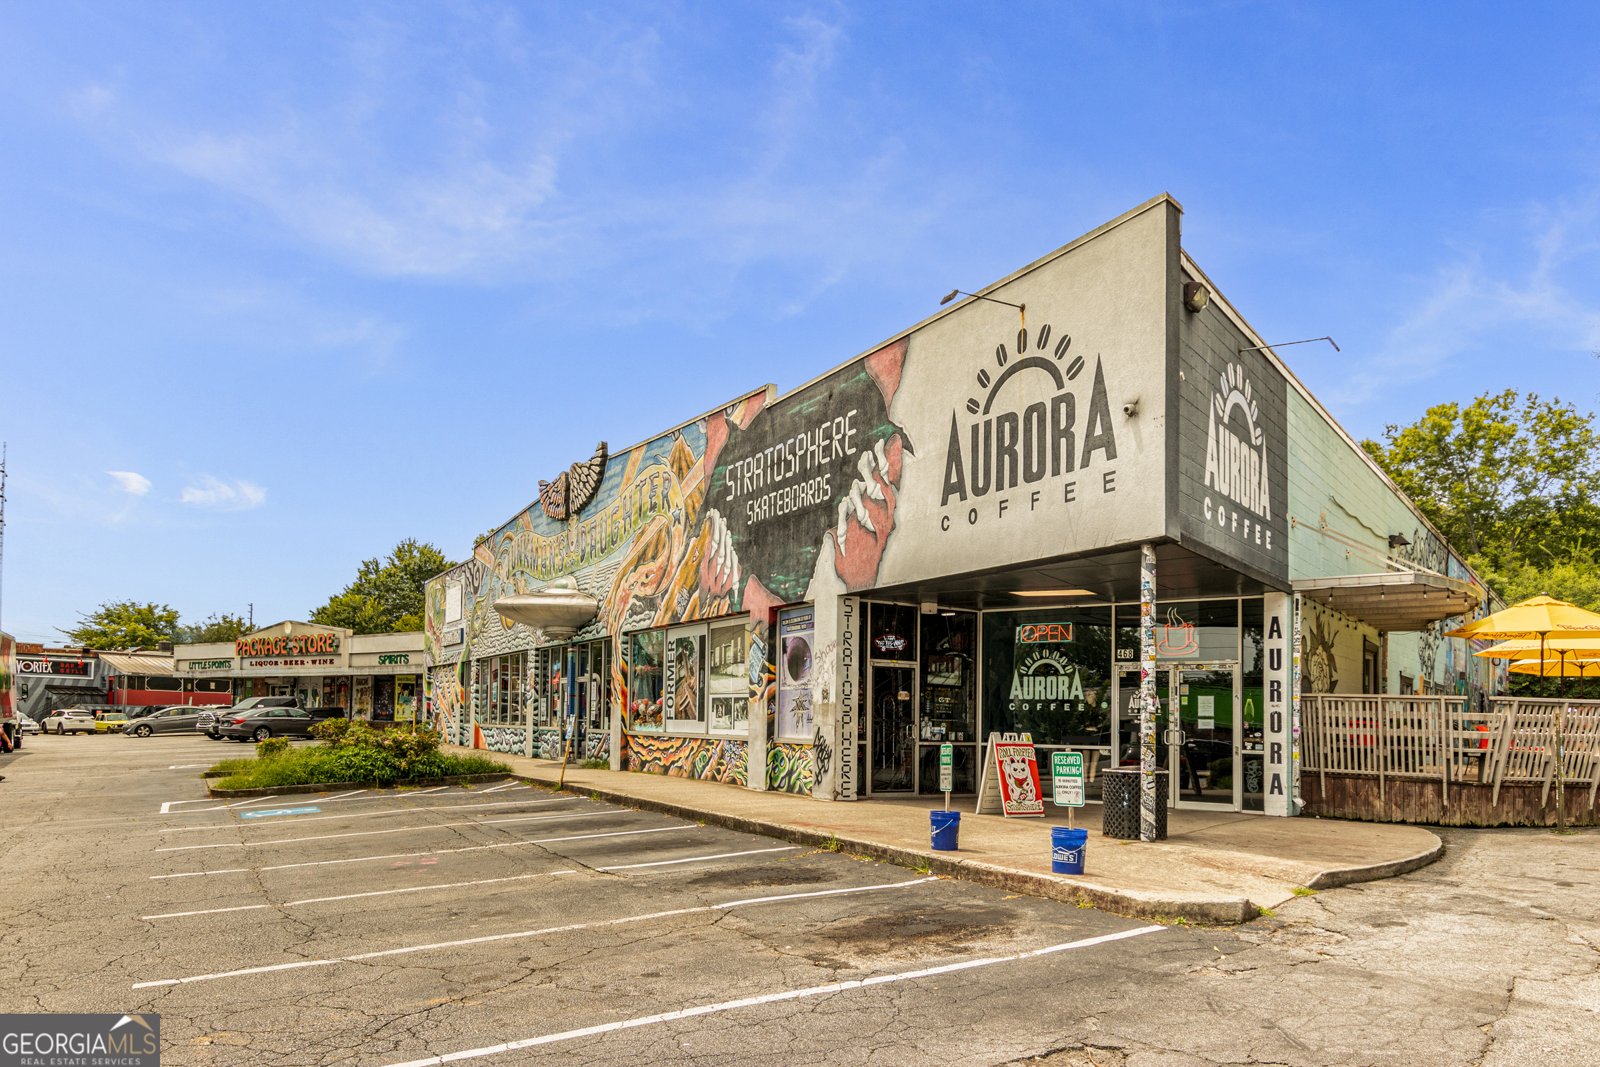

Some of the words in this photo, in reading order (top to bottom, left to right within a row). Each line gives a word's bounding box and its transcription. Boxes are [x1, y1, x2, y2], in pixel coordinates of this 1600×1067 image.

[940, 352, 1118, 506] AURORA
[726, 409, 858, 501] STRATOSPHERE
[1204, 390, 1271, 521] AURORA
[746, 473, 831, 525] SKATEBOARDS
[941, 470, 1117, 531] COFFEE
[579, 471, 672, 565] DAUGHTER
[1204, 496, 1272, 550] COFFEE
[235, 637, 288, 656] PACKAGE
[292, 633, 335, 654] STORE
[1021, 624, 1072, 642] OPEN
[16, 659, 53, 675] VORTEX
[211, 660, 232, 669] POINTS
[378, 654, 410, 665] SPIRITS
[1117, 650, 1133, 658] 468
[666, 640, 675, 720] FORMER
[1009, 668, 1084, 700] AURORA
[841, 598, 854, 798] STRATOSPHERE
[1009, 703, 1085, 711] COFFEE
[1128, 695, 1161, 708] AUA
[1268, 616, 1284, 795] AURORA
[1054, 755, 1080, 764] RESERVED
[1056, 765, 1079, 774] PARKING
